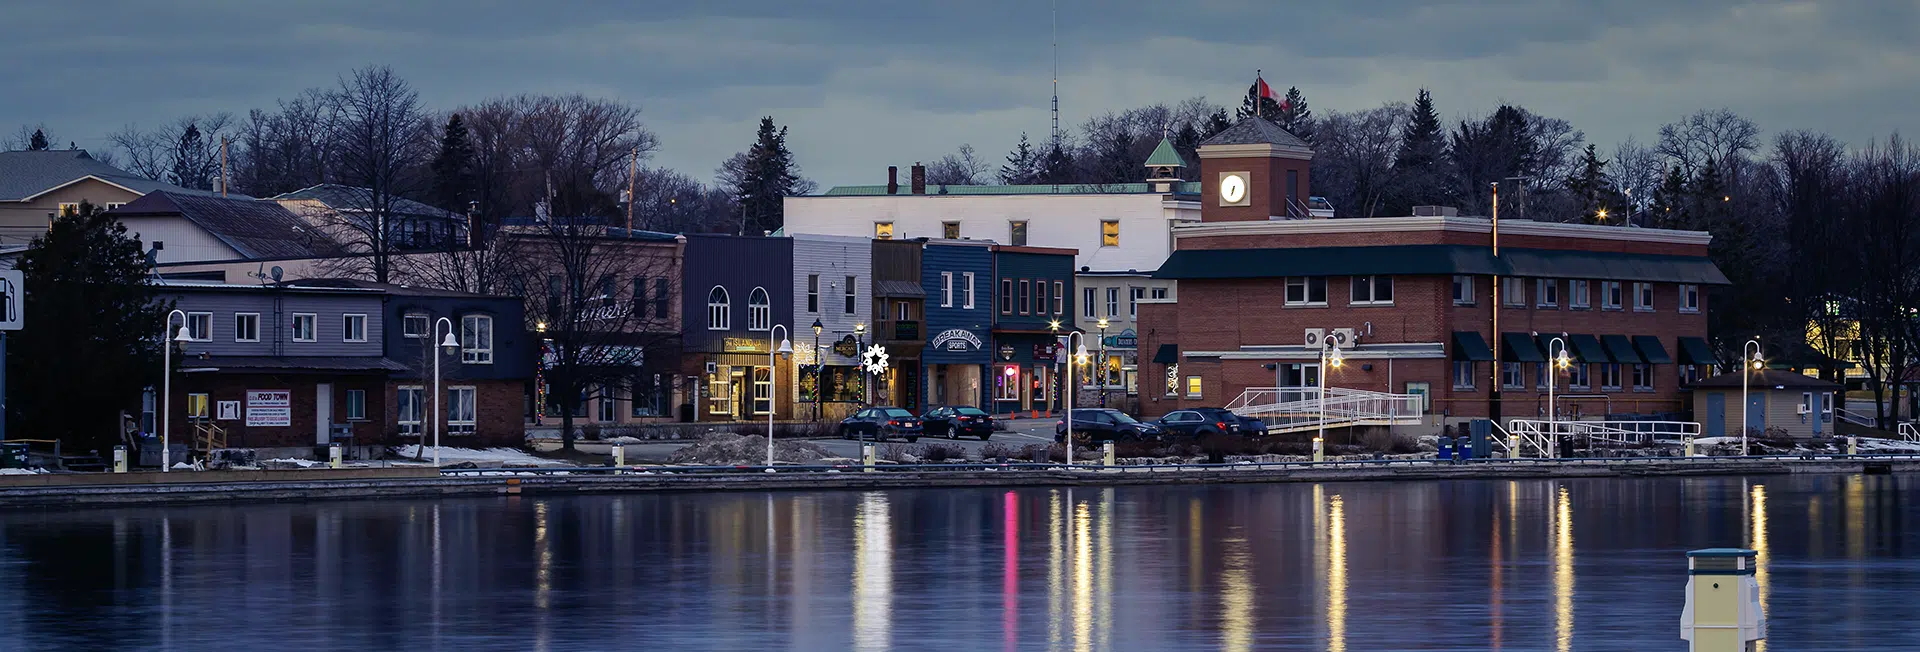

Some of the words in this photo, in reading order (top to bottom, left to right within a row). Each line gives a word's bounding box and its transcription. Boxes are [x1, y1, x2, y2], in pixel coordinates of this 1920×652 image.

[933, 330, 982, 349] BREAKAWAY
[949, 341, 966, 349] SPORTS
[258, 393, 272, 401] FOOD
[273, 393, 288, 401] TOWN
